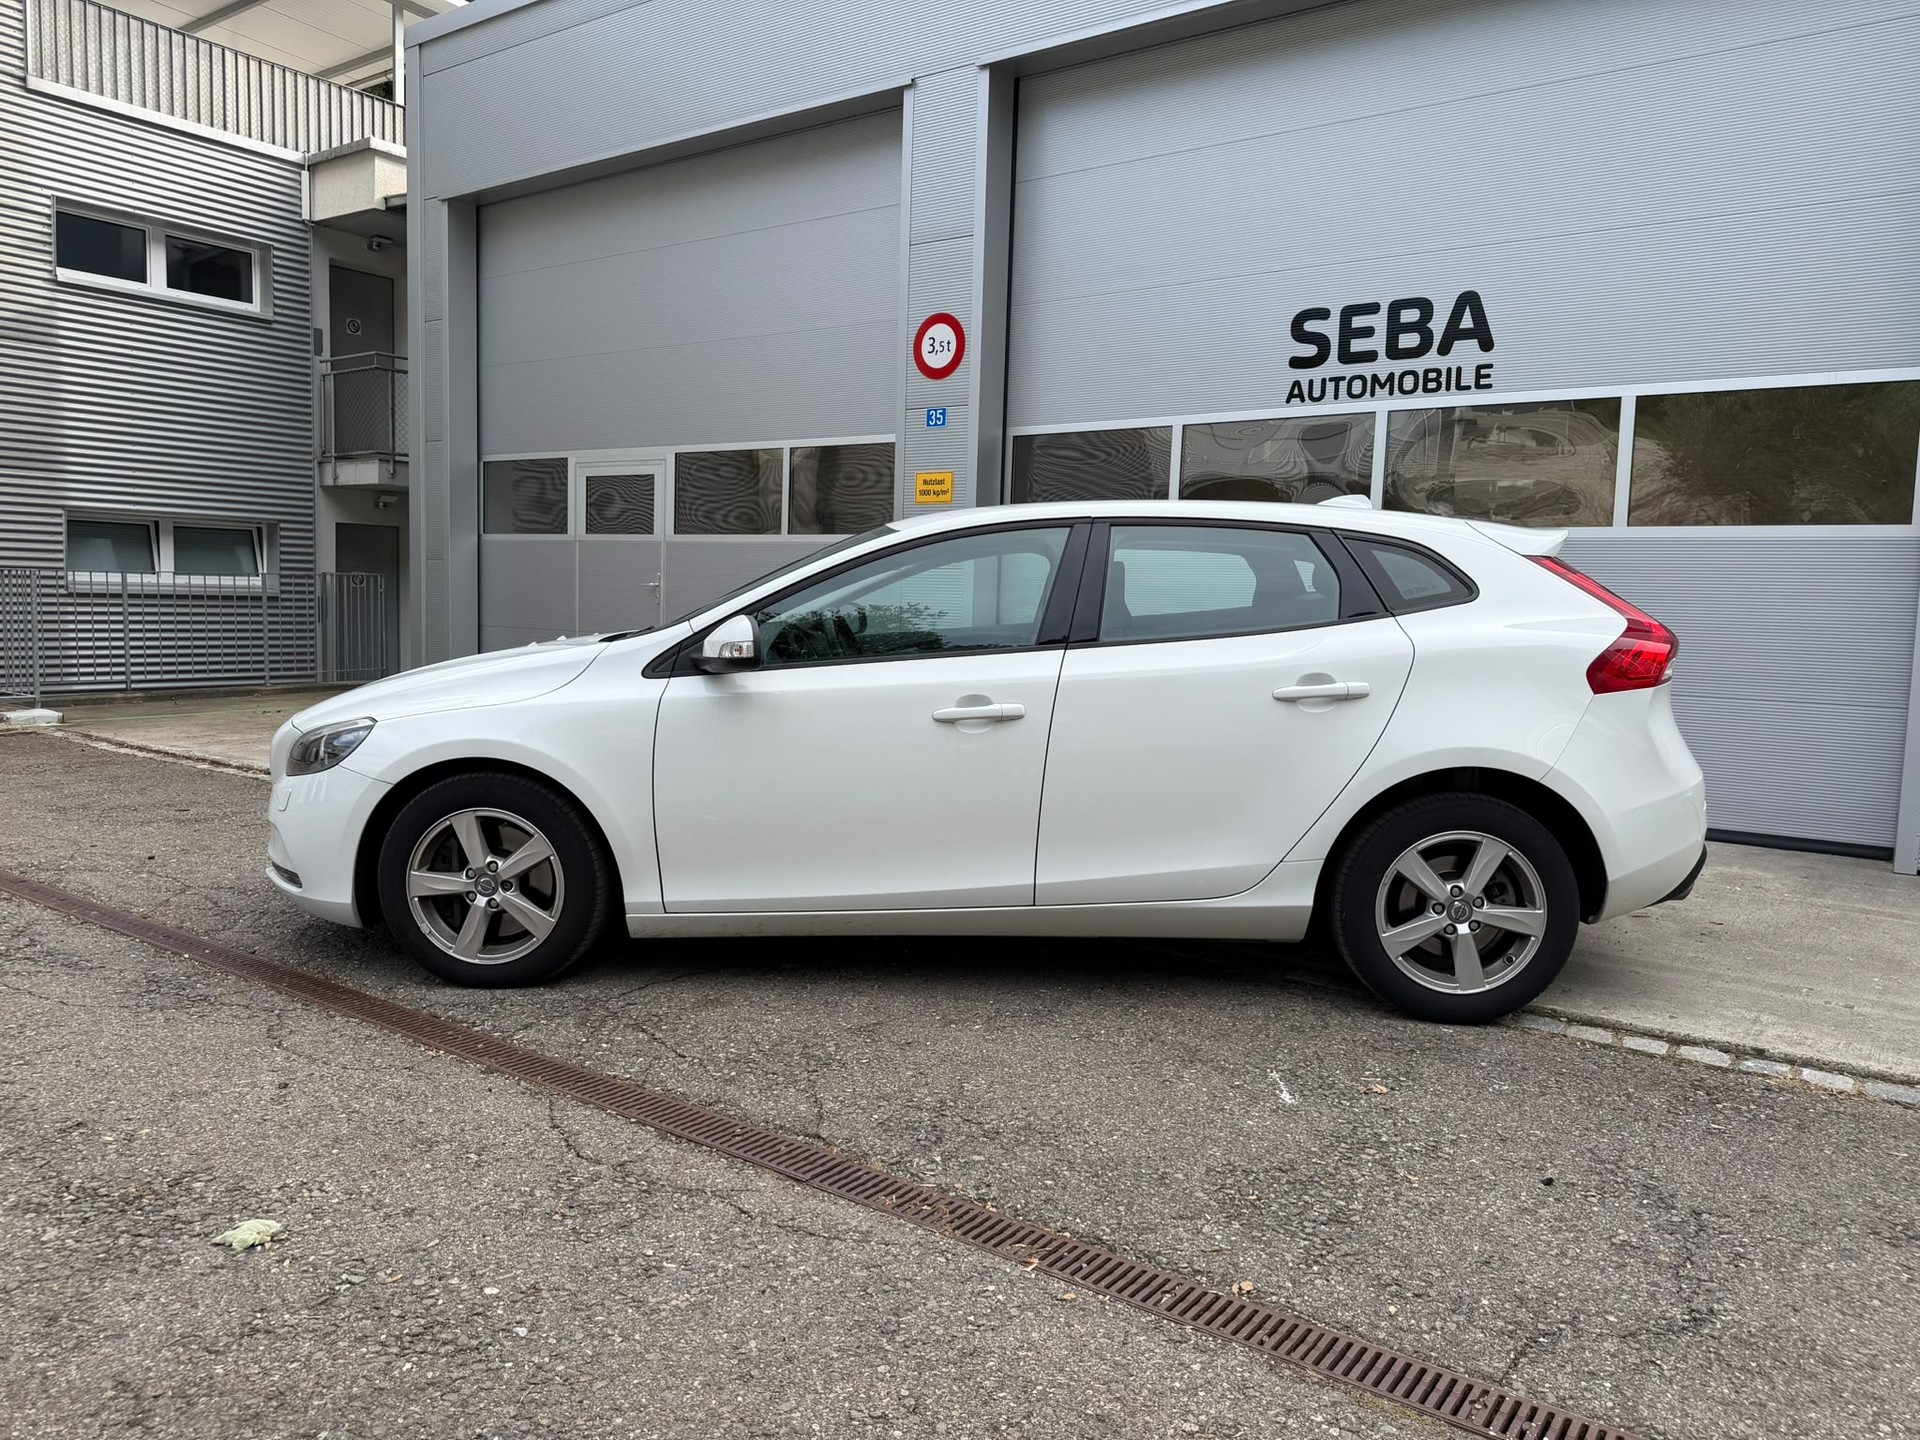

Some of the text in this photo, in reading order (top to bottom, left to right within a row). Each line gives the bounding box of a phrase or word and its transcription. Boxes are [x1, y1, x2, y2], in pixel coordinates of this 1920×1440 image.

[1288, 290, 1495, 369] SEBA
[927, 336, 952, 356] 3,5 t
[1285, 363, 1494, 404] AUTOMOBILE
[928, 409, 944, 425] 35
[922, 478, 946, 486] Nutzlast
[918, 489, 931, 497] 1000
